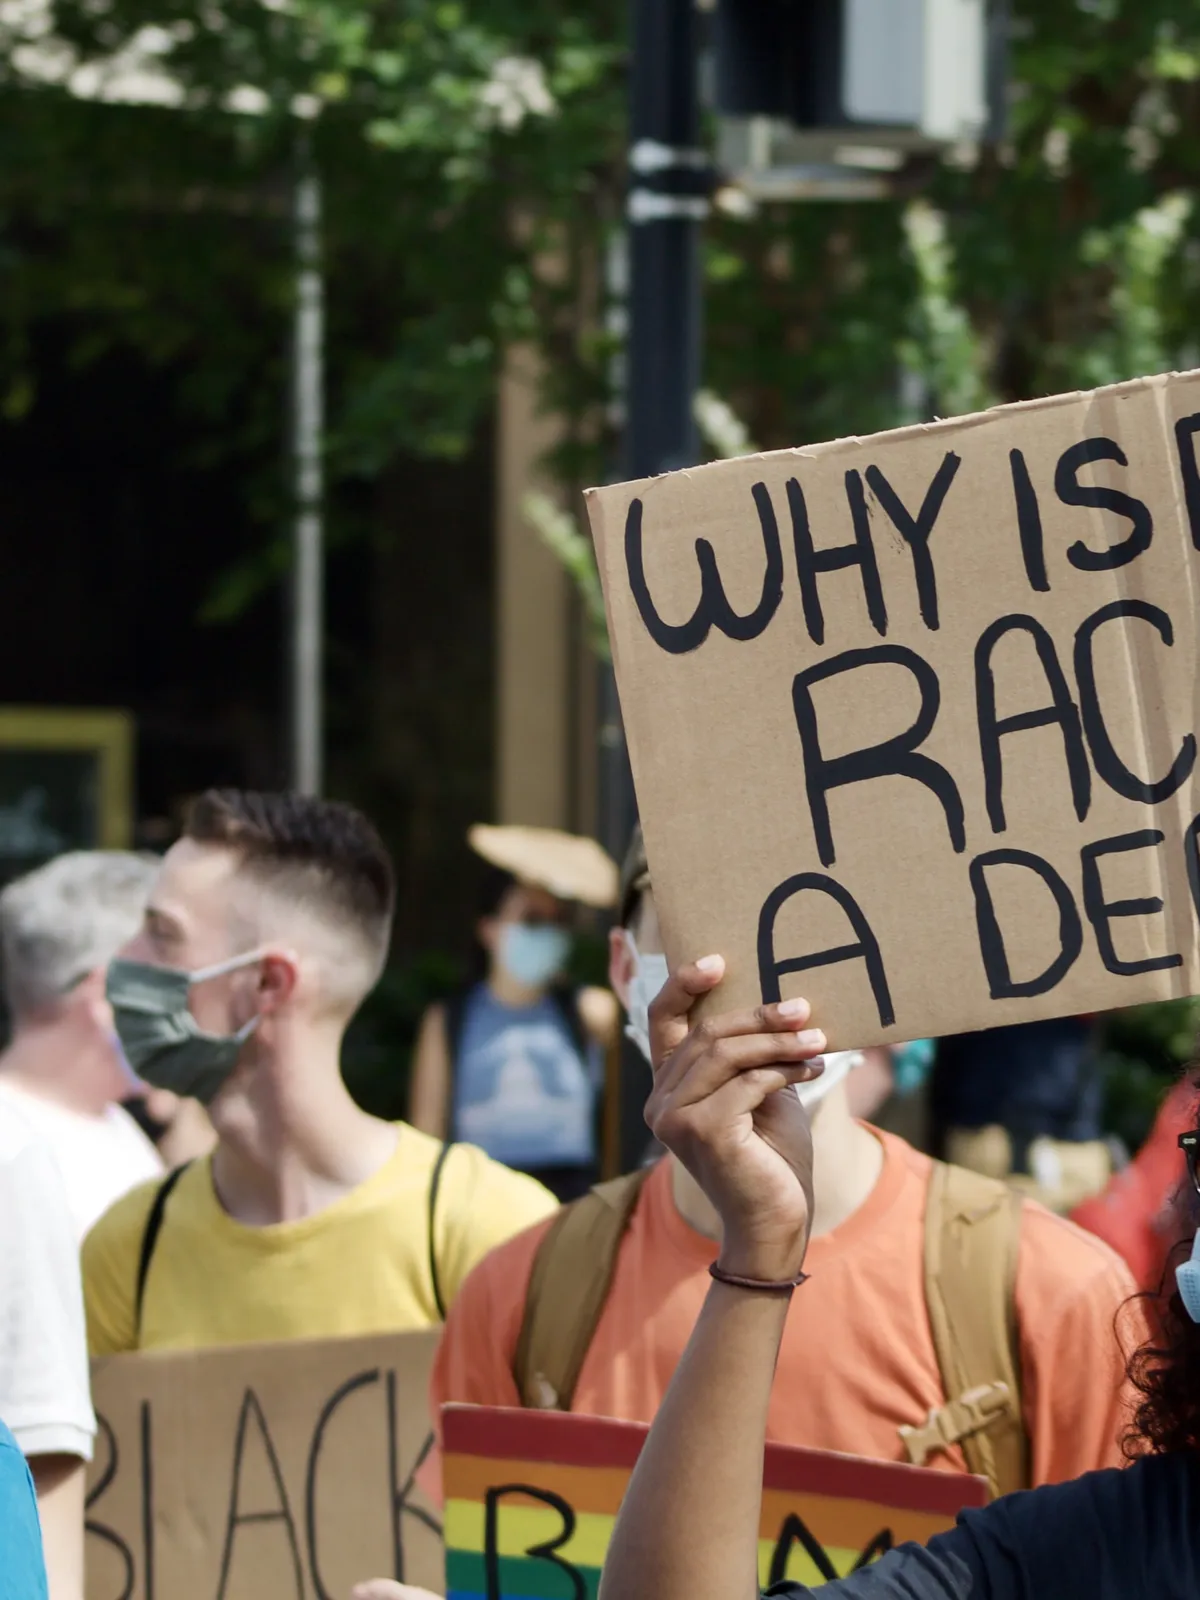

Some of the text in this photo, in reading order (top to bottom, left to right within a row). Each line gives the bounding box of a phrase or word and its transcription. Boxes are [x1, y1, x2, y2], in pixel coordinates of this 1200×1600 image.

[624, 450, 962, 654] WHY
[1009, 437, 1154, 592] IS
[757, 872, 895, 1028] A
